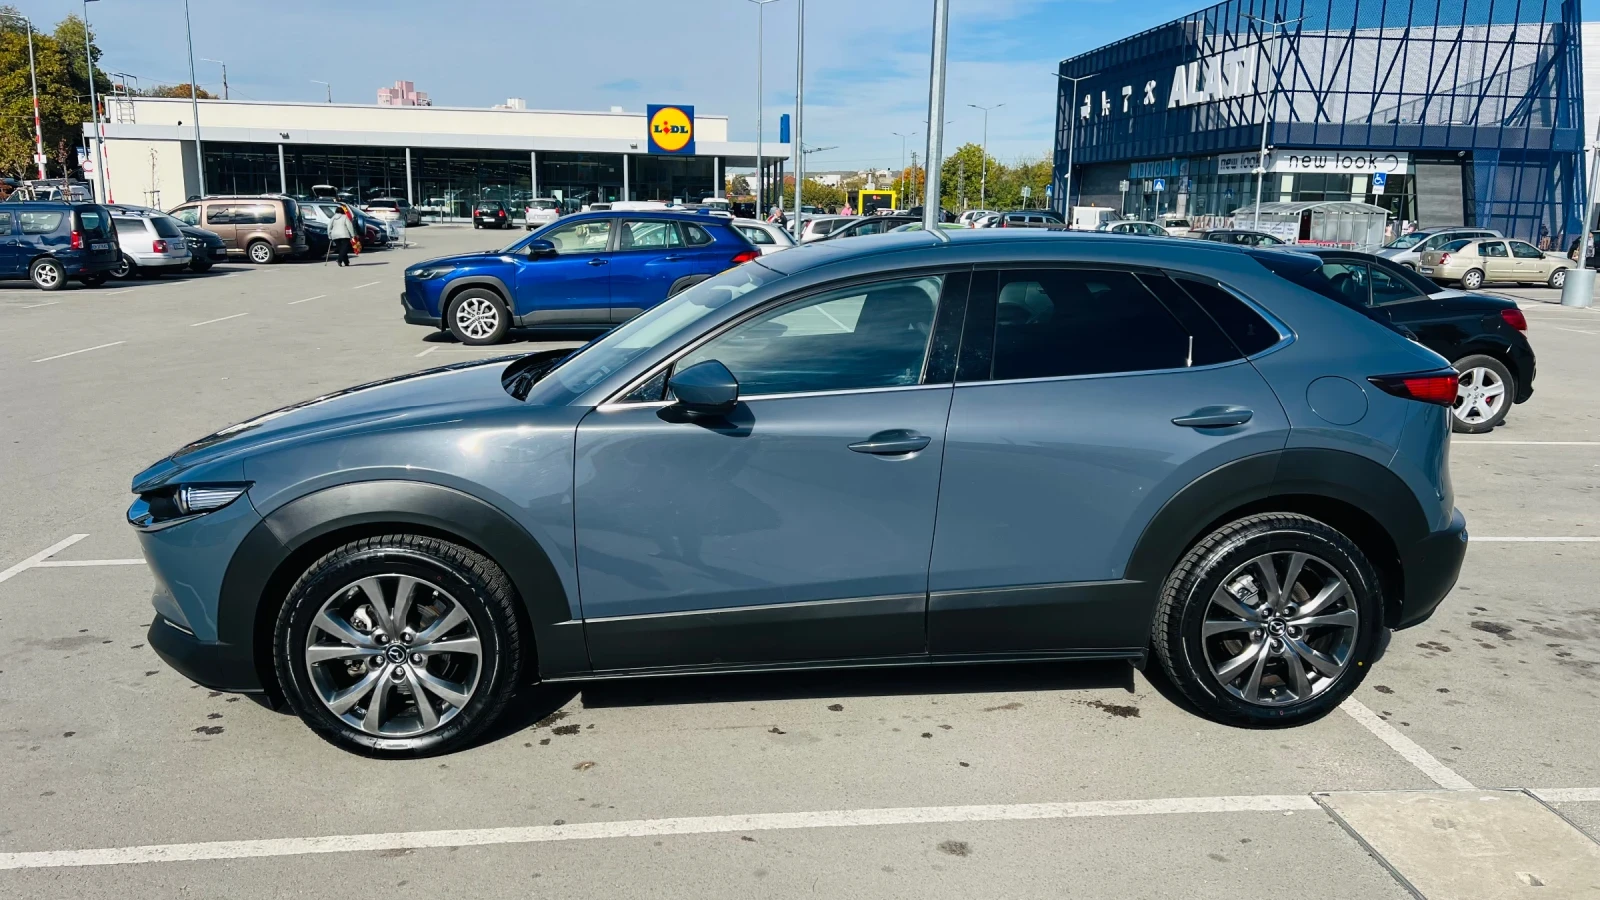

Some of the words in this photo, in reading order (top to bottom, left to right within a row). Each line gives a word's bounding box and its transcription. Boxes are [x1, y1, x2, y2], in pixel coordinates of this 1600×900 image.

[1168, 45, 1256, 109] ALATI
[1139, 160, 1171, 178] ВХОД
[1220, 157, 1238, 169] new
[1288, 154, 1328, 169] new
[1335, 152, 1377, 170] look
